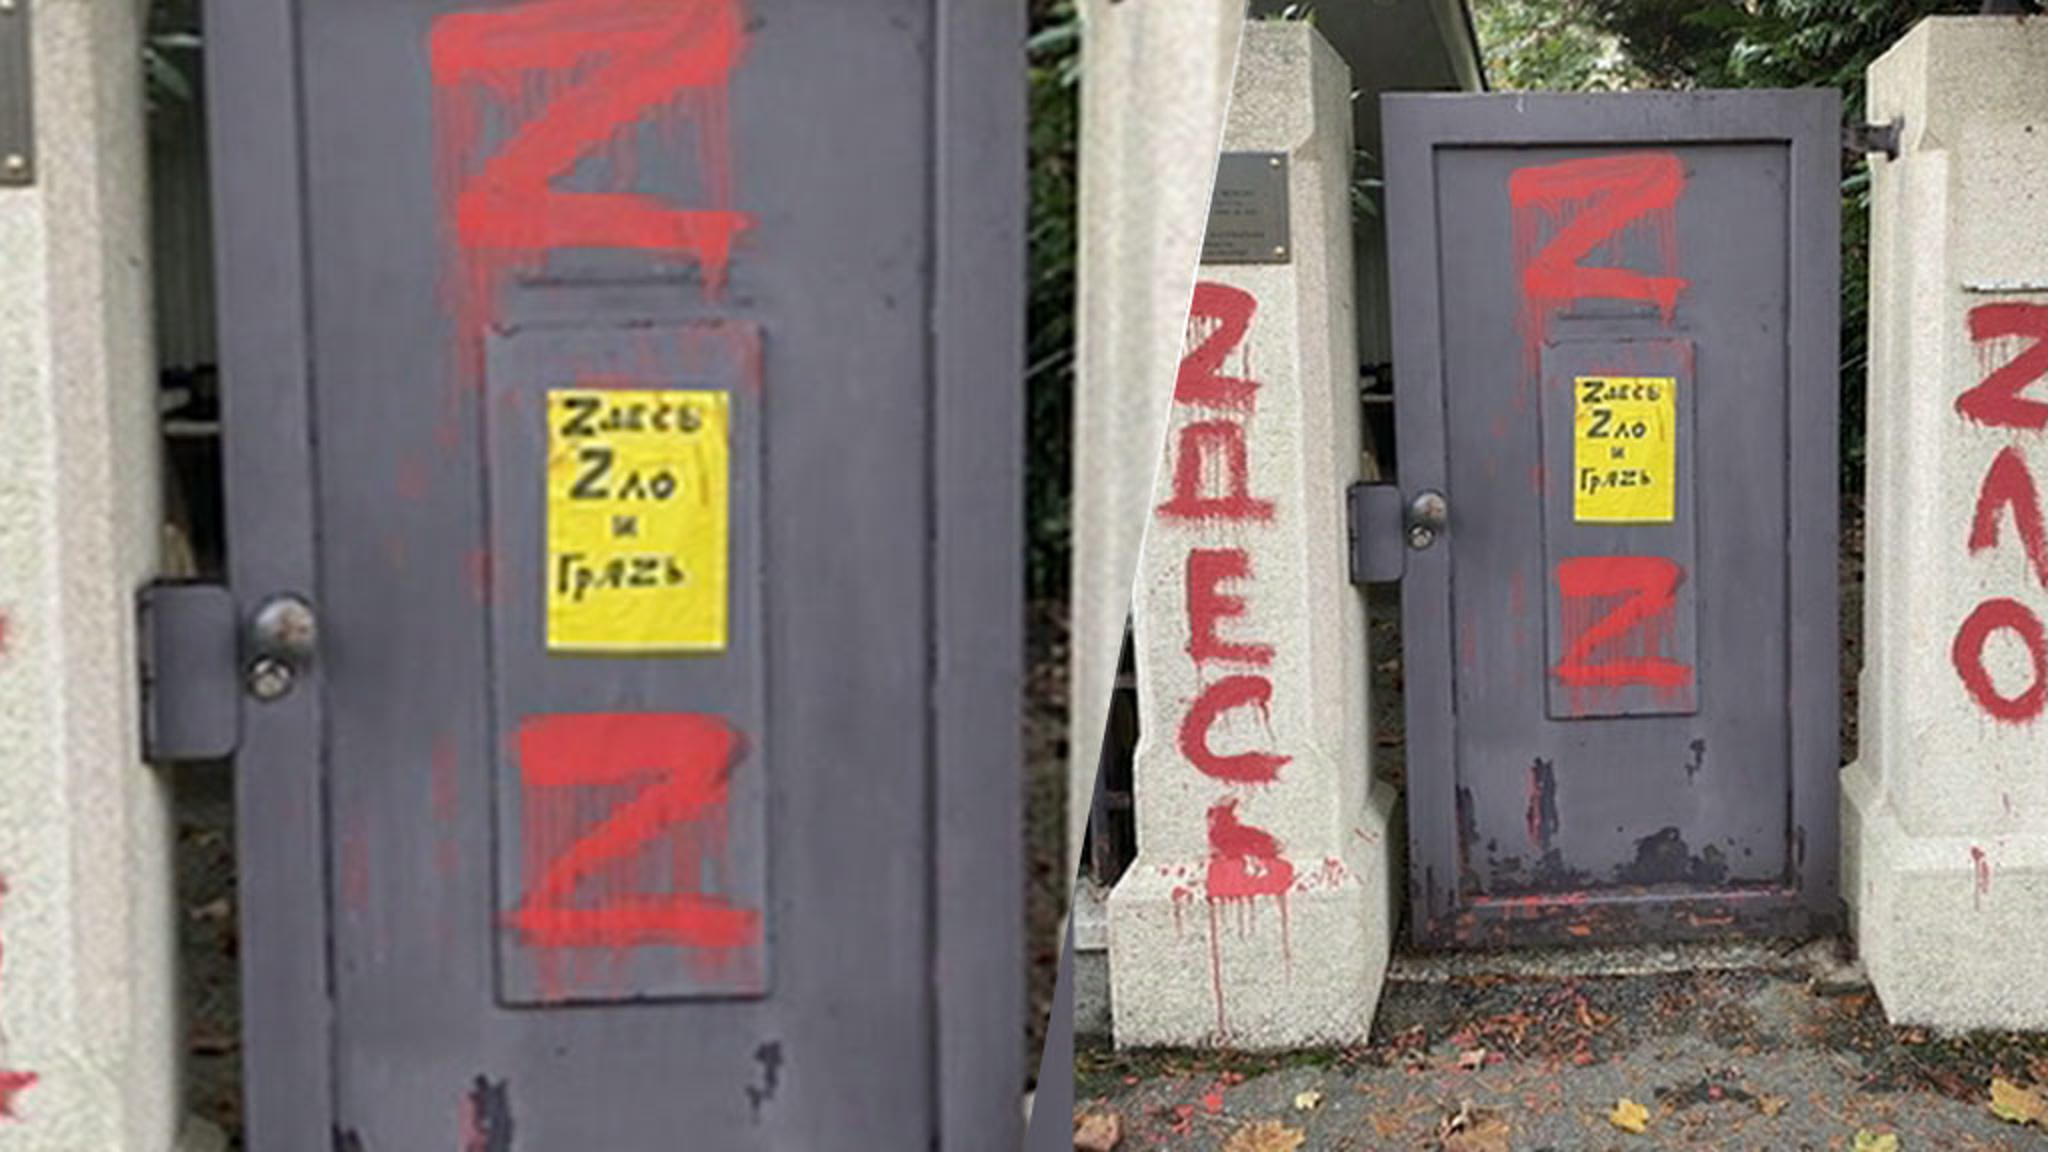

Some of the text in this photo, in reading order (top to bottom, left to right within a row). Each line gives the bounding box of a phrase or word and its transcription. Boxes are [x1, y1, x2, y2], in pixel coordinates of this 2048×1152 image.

[427, 0, 758, 262] Z
[1508, 152, 1689, 304] Z
[1555, 556, 1691, 686] Z
[509, 712, 758, 948] Z
